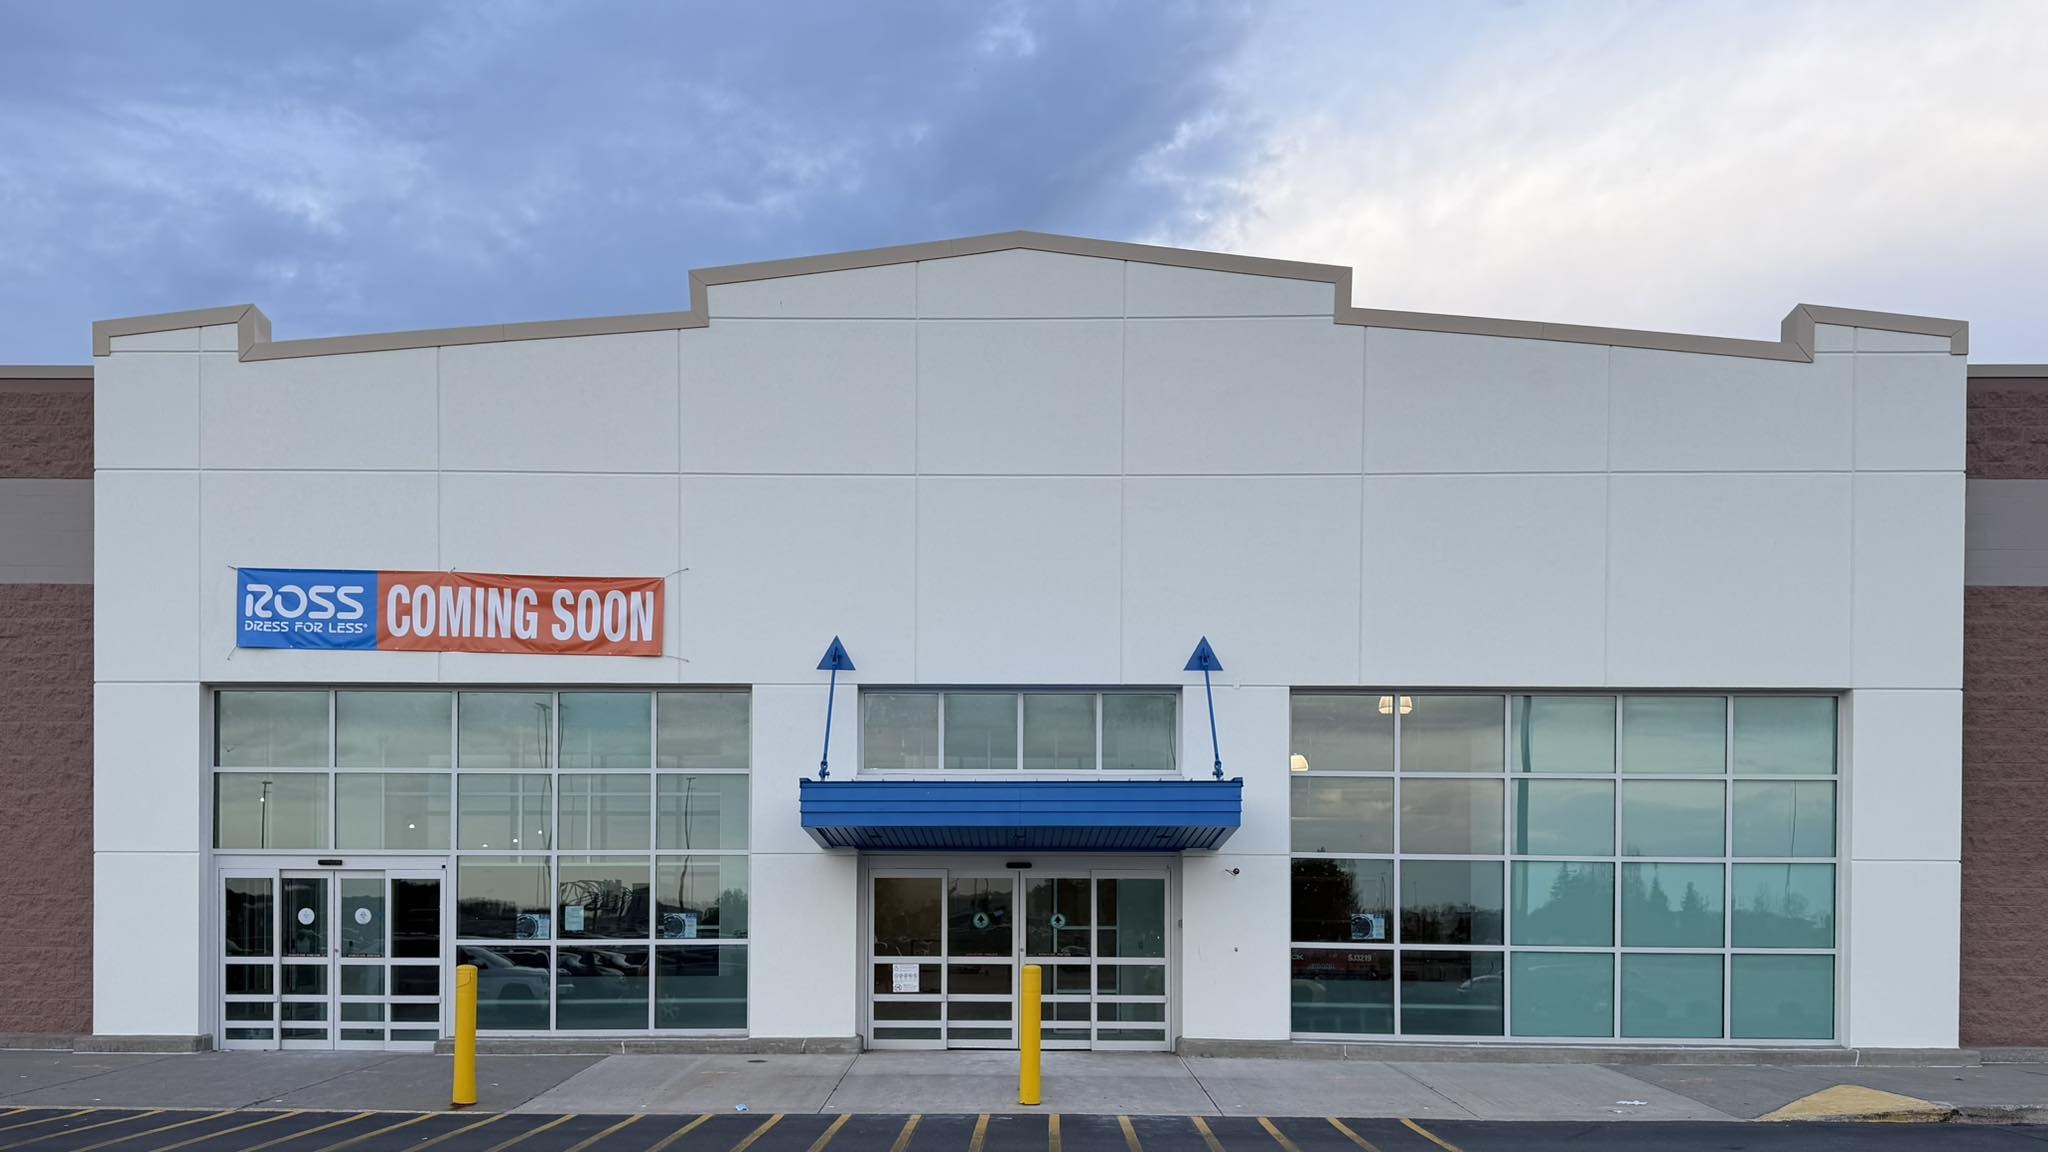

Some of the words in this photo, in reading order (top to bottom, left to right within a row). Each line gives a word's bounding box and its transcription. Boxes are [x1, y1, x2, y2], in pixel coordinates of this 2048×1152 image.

[245, 584, 364, 619] ROSS
[386, 584, 538, 640] COMING
[551, 588, 654, 642] SOON
[244, 620, 289, 632] DRESS
[295, 621, 323, 633] FOR
